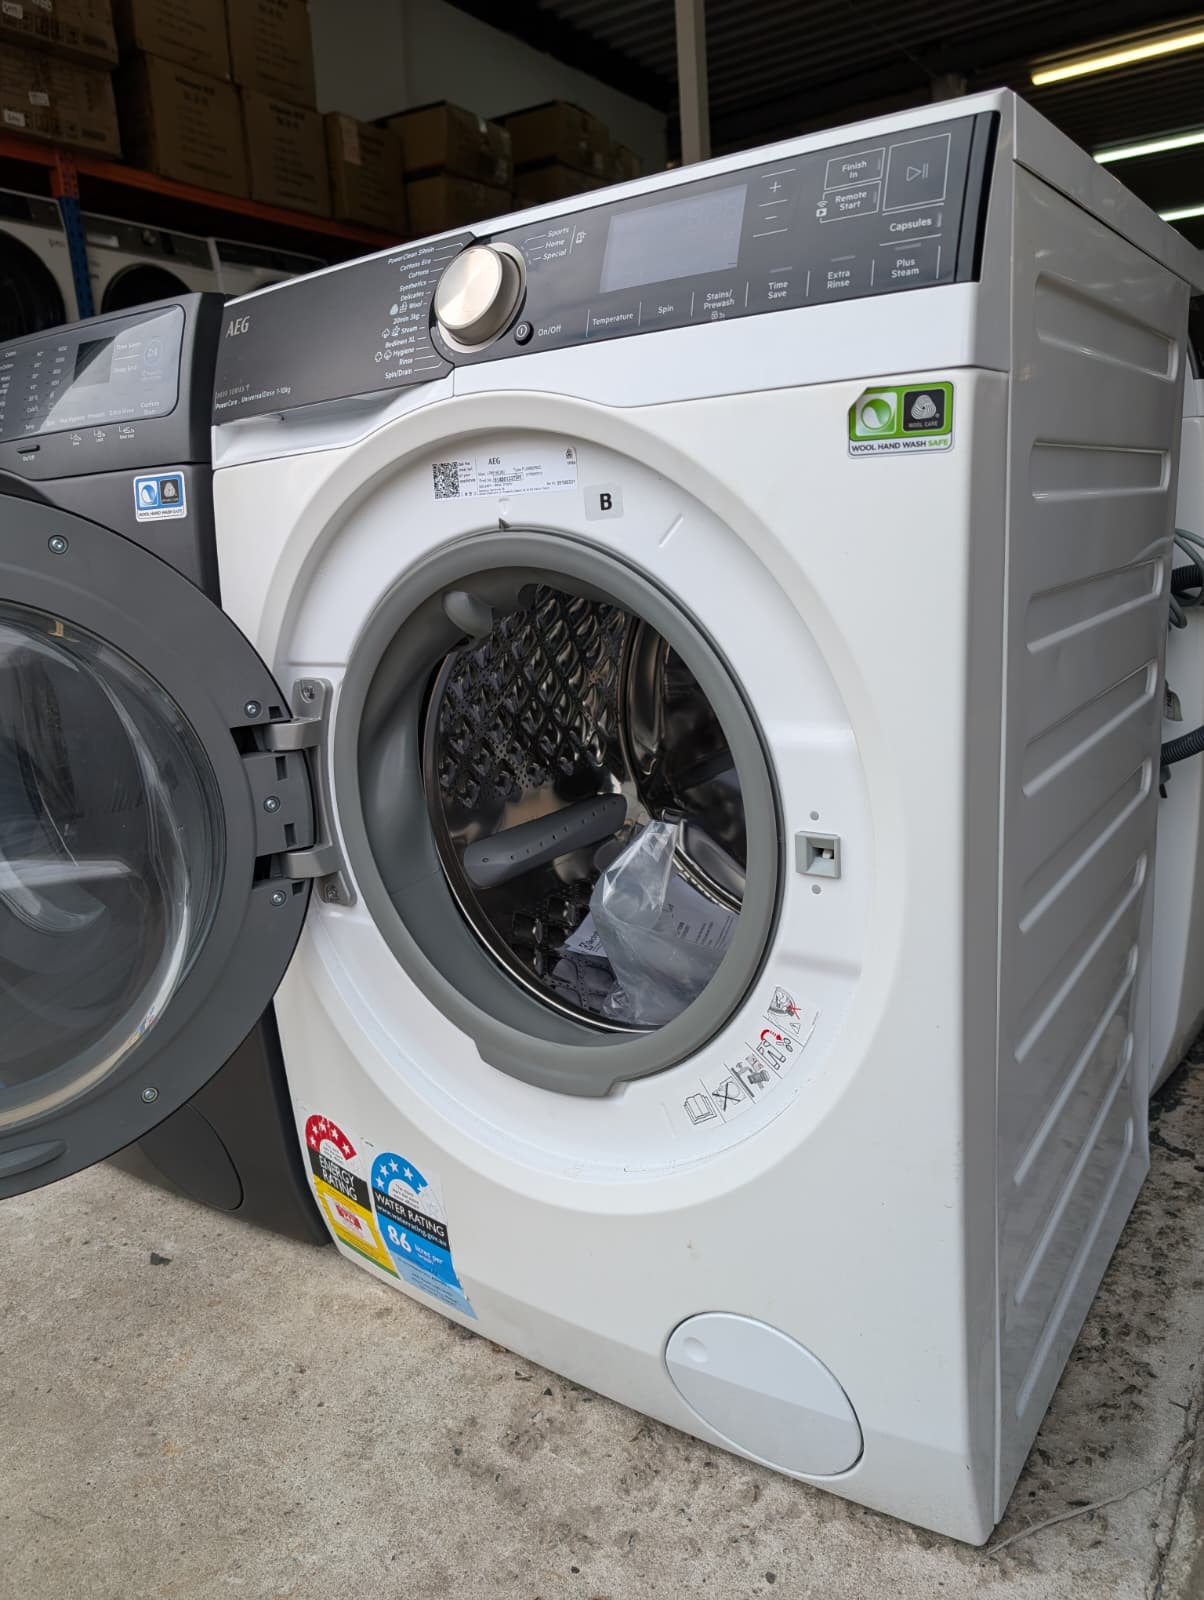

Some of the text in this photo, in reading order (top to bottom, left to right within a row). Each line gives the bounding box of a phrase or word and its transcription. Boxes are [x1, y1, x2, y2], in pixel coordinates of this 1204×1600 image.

[842, 160, 868, 173] Finish
[849, 171, 858, 179] In
[835, 191, 867, 203] Remote
[840, 201, 861, 211] Start
[889, 217, 933, 232] Capsules
[547, 226, 570, 238] Sports
[545, 239, 565, 249] Home
[543, 248, 567, 261] Special
[400, 262, 421, 272] Cottons
[896, 258, 916, 268] Plus
[408, 269, 430, 279] Cottons
[827, 269, 851, 281] Extra
[891, 267, 920, 279] Steam
[400, 281, 427, 292] Synthetics
[768, 281, 789, 291] Time
[827, 279, 850, 289] Rinse
[400, 291, 425, 302] Delicates
[706, 288, 734, 302] Stains/
[768, 290, 788, 300] Save
[409, 300, 423, 309] Wool
[658, 304, 675, 315] Spin
[703, 299, 735, 310] Prewash
[591, 313, 634, 326] Temperature
[225, 315, 251, 338] AEG
[400, 326, 418, 334] Steam
[537, 324, 562, 337] On/Off
[393, 347, 415, 357] Hygiene
[399, 357, 414, 366] Rinse
[384, 368, 413, 379] Spin/Drain
[241, 390, 276, 403] UniversalDose
[851, 438, 948, 452] WOOL HAND WASH SAFE
[488, 456, 501, 465] AEG
[600, 493, 612, 511] B
[319, 1154, 354, 1187] ENERGY
[323, 1168, 358, 1201] RATING
[374, 1191, 406, 1217] WATER
[408, 1209, 445, 1237] RATING
[388, 1225, 412, 1253] 86
